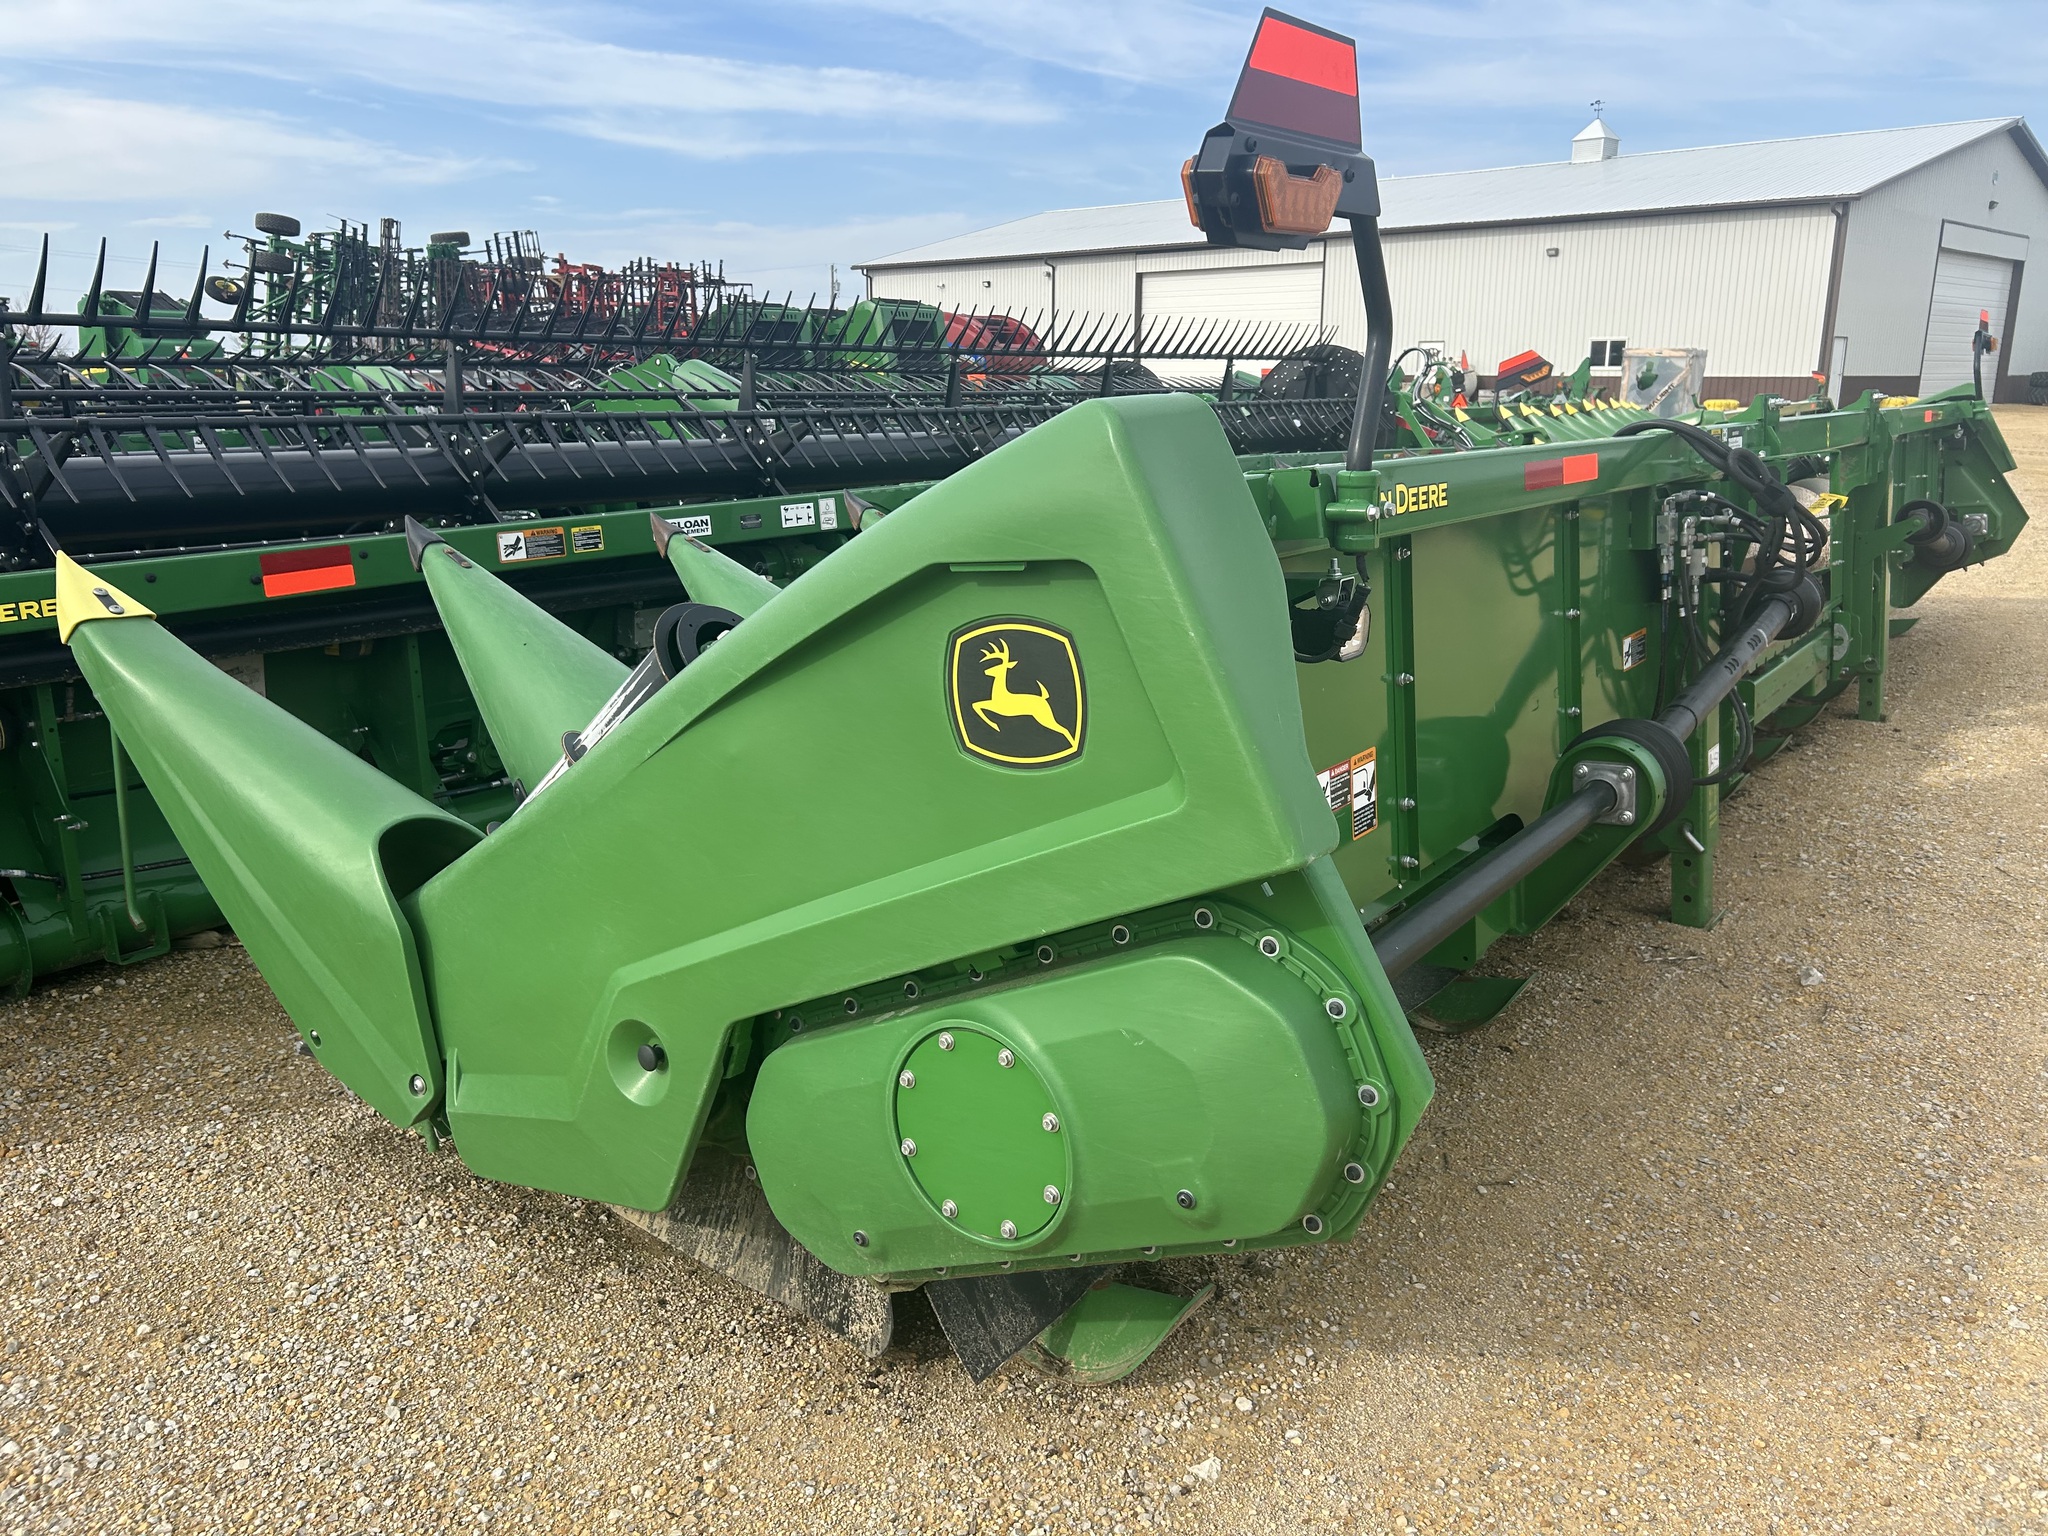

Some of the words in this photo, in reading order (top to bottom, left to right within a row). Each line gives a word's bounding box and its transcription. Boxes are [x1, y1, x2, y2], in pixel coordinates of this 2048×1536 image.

[1395, 482, 1448, 515] DEERE
[535, 528, 558, 536] WARNING
[686, 527, 709, 535] EMENT
